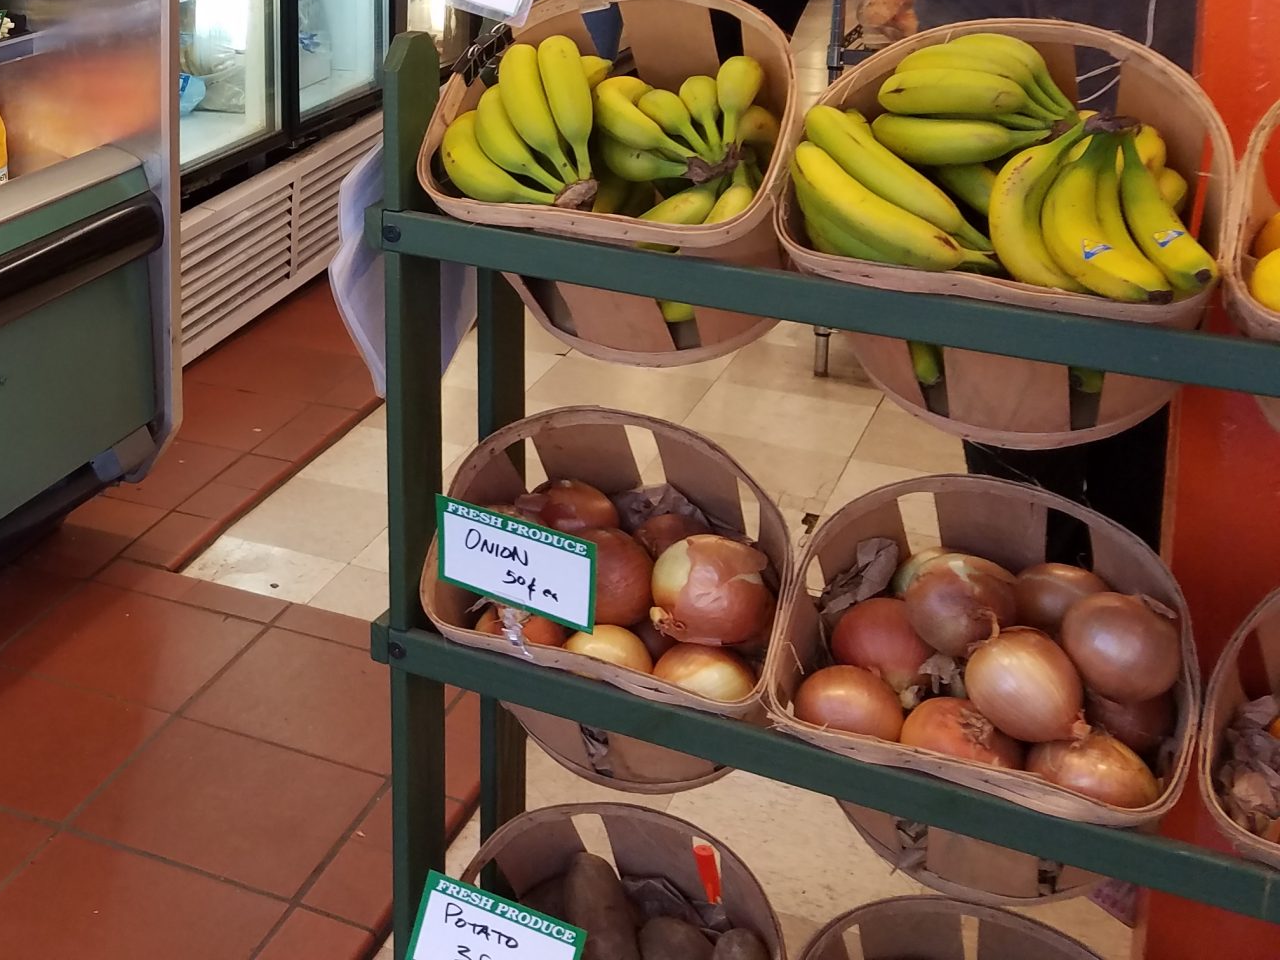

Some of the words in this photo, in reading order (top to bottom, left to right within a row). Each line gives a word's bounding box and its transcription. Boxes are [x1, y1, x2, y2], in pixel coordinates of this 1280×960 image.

[446, 501, 503, 529] FRESH
[505, 520, 588, 556] PRODUCE
[464, 527, 529, 567] ONION
[542, 588, 559, 603] ea
[435, 878, 495, 910] FRESH
[495, 902, 577, 944] PRODUCE
[443, 902, 519, 950] POTATO
